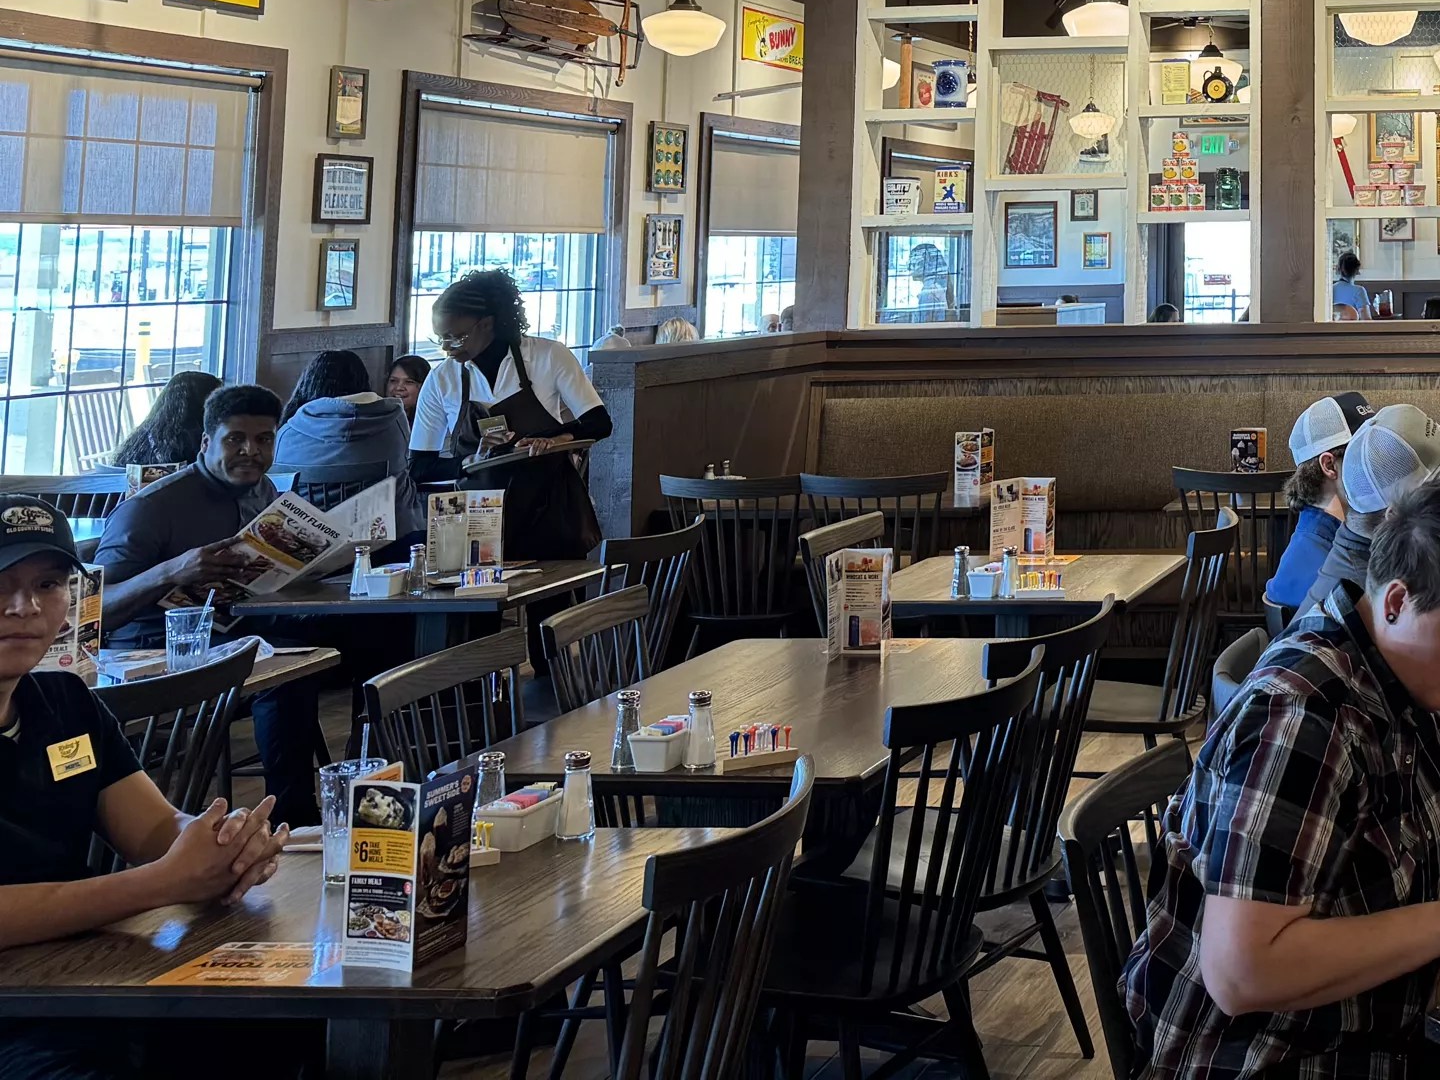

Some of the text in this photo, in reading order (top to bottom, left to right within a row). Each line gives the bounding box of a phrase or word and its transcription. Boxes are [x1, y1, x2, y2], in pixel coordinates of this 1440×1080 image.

[768, 27, 796, 50] BUNNY
[1202, 136, 1224, 154] EXIT
[324, 192, 348, 208] PLEASE
[280, 498, 340, 539] SAVORY FLAVORS
[424, 788, 460, 808] SWEET SIDE
[426, 780, 459, 799] SUMMER'S
[354, 840, 368, 862] $6
